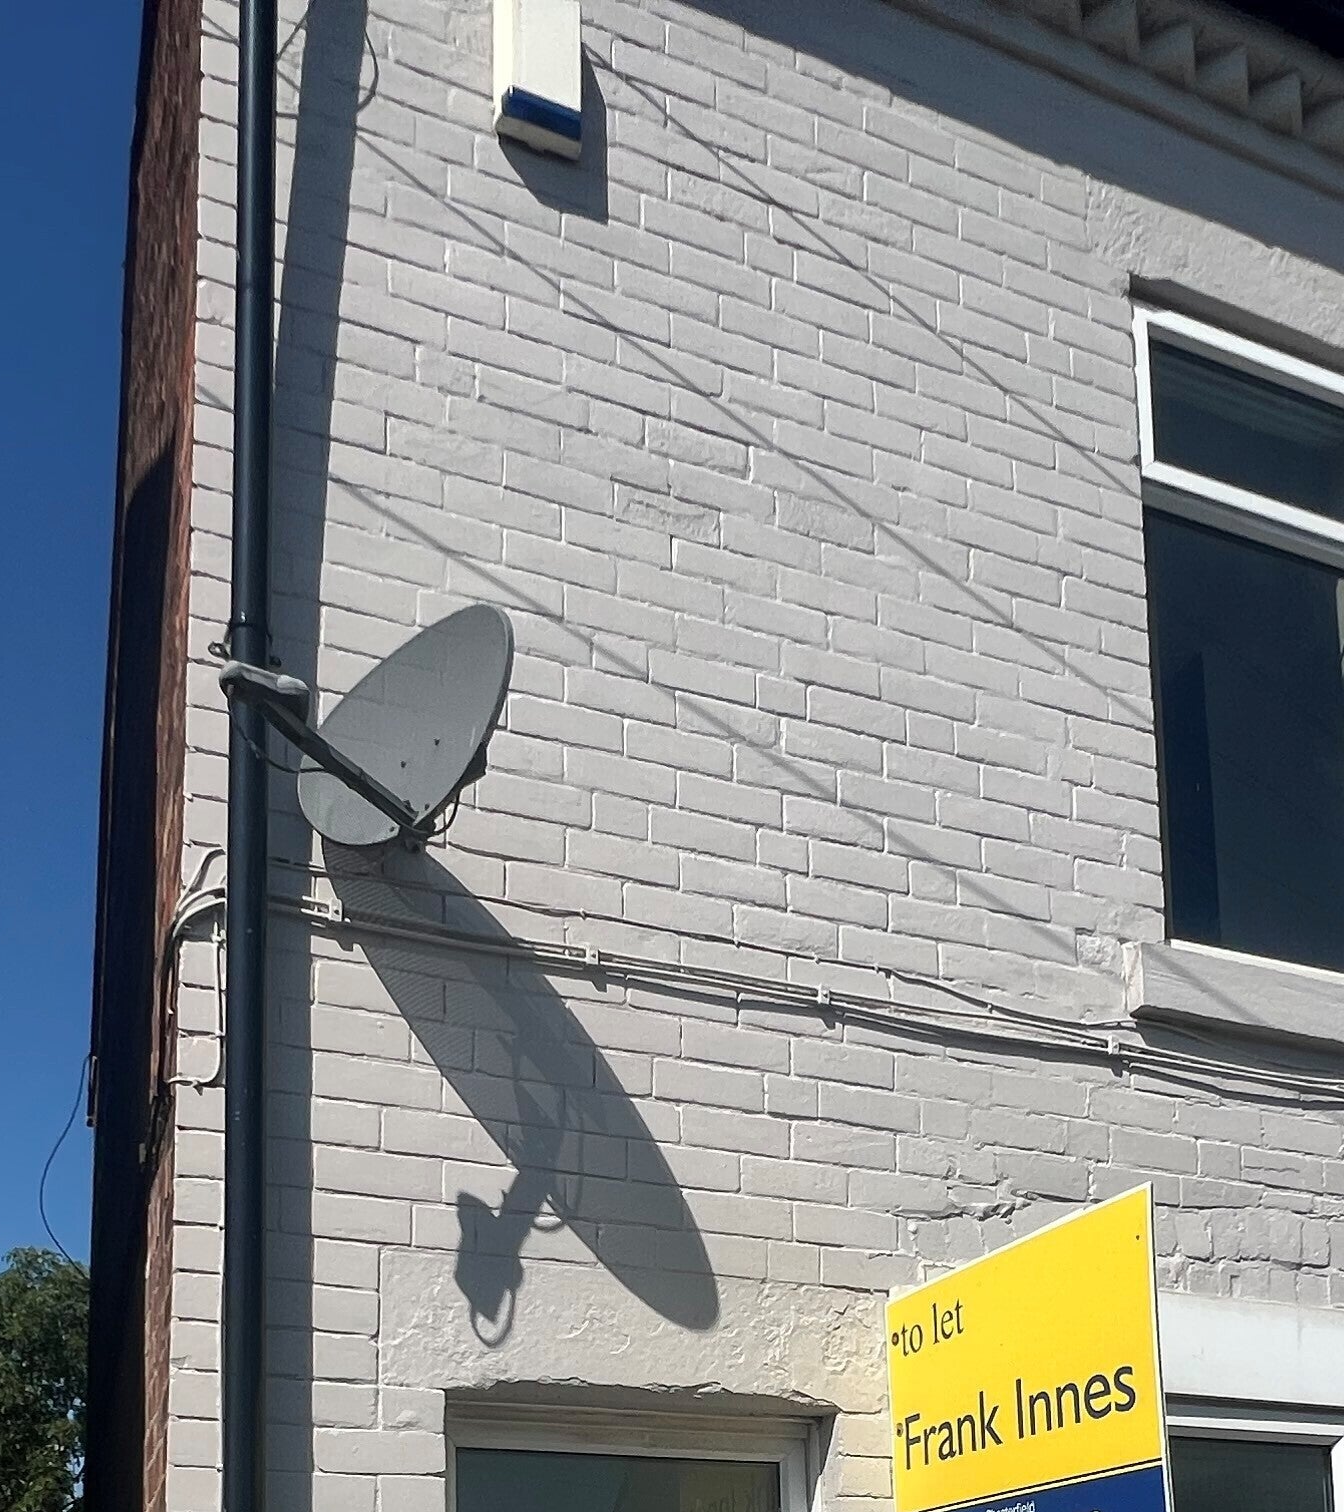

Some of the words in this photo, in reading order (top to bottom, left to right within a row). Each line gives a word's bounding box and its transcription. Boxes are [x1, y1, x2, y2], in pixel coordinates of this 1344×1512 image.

[901, 1323, 924, 1357] to
[932, 1298, 964, 1345] let
[905, 1391, 1003, 1470] Frank
[1016, 1366, 1136, 1439] Innes
